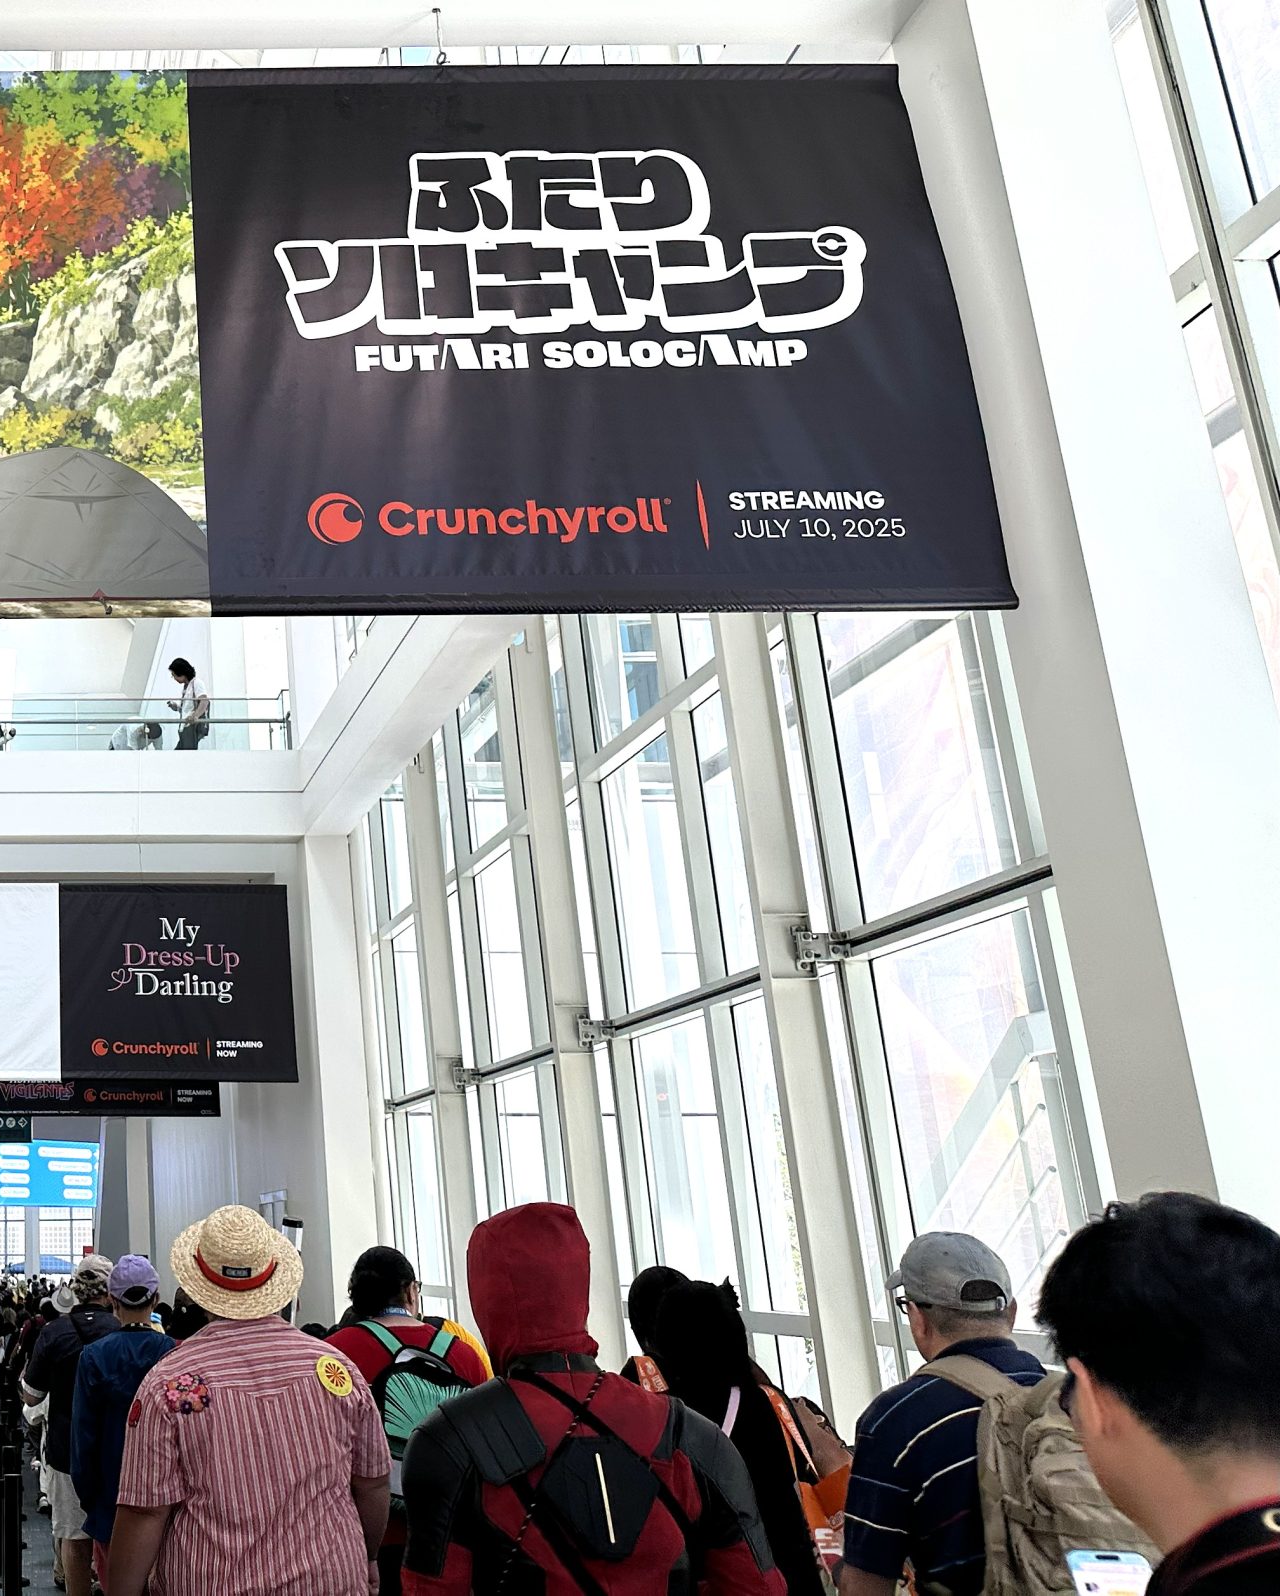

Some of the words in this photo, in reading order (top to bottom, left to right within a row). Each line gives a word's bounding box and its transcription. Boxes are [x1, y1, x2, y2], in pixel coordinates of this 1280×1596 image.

[408, 149, 711, 238] ふたり
[274, 226, 868, 340] ソロキャンプ
[354, 339, 530, 373] FUTARI
[542, 334, 809, 371] SOLOCAMP
[728, 490, 885, 511] STREAMING
[733, 518, 791, 539] JULY
[798, 517, 837, 542] 10,
[842, 517, 906, 538] 2025
[158, 917, 201, 948] My
[122, 943, 240, 974] Dress-Up
[135, 972, 234, 1004] Darling
[112, 1041, 198, 1058] Crunchyroll
[216, 1040, 264, 1049] STREAMING
[216, 1050, 238, 1058] NOW
[99, 1089, 164, 1103] Crunchyroll
